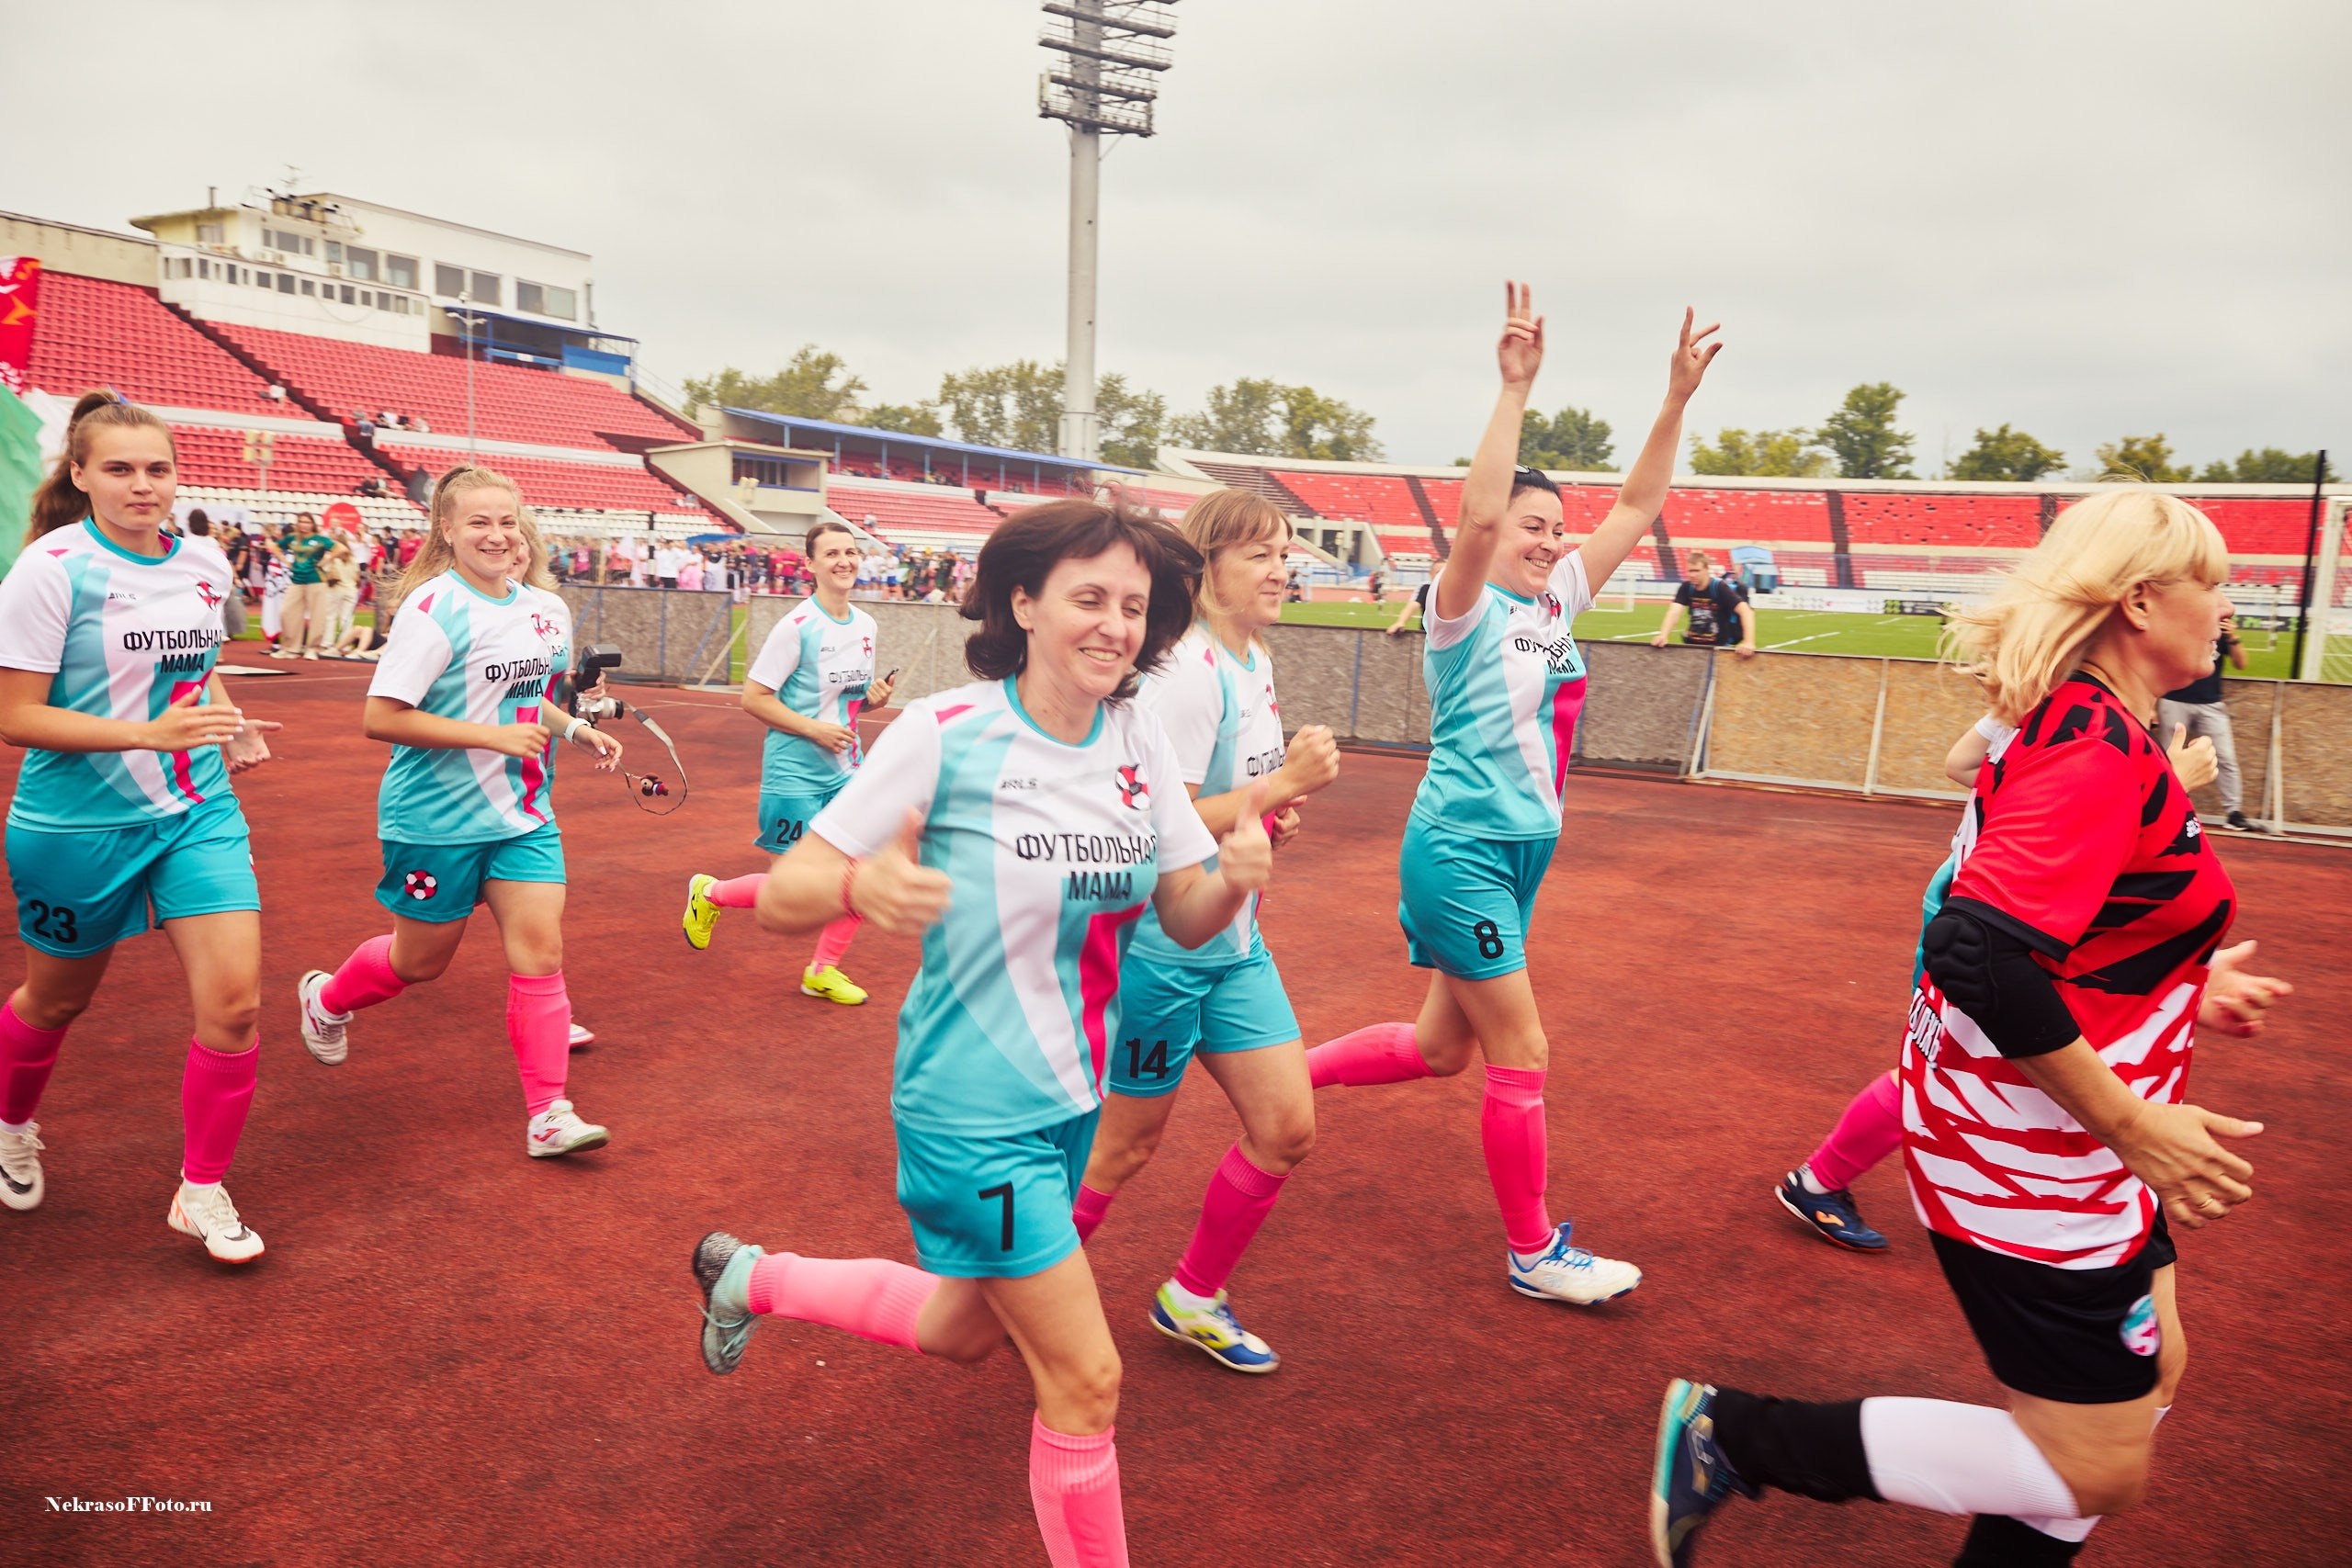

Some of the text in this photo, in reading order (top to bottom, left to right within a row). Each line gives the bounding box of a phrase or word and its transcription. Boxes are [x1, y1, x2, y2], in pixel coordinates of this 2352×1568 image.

[123, 629, 221, 651] ФУТБОЛЬНА
[160, 653, 205, 673] МАМА
[485, 657, 552, 682] ФУТБОЛЬН
[505, 679, 544, 699] МАМА
[776, 818, 803, 845] 24
[1067, 871, 1133, 901] МАМА
[28, 899, 77, 943] 23
[1473, 919, 1504, 960] 8
[1125, 1037, 1170, 1079] 14
[978, 1181, 1014, 1252] 7
